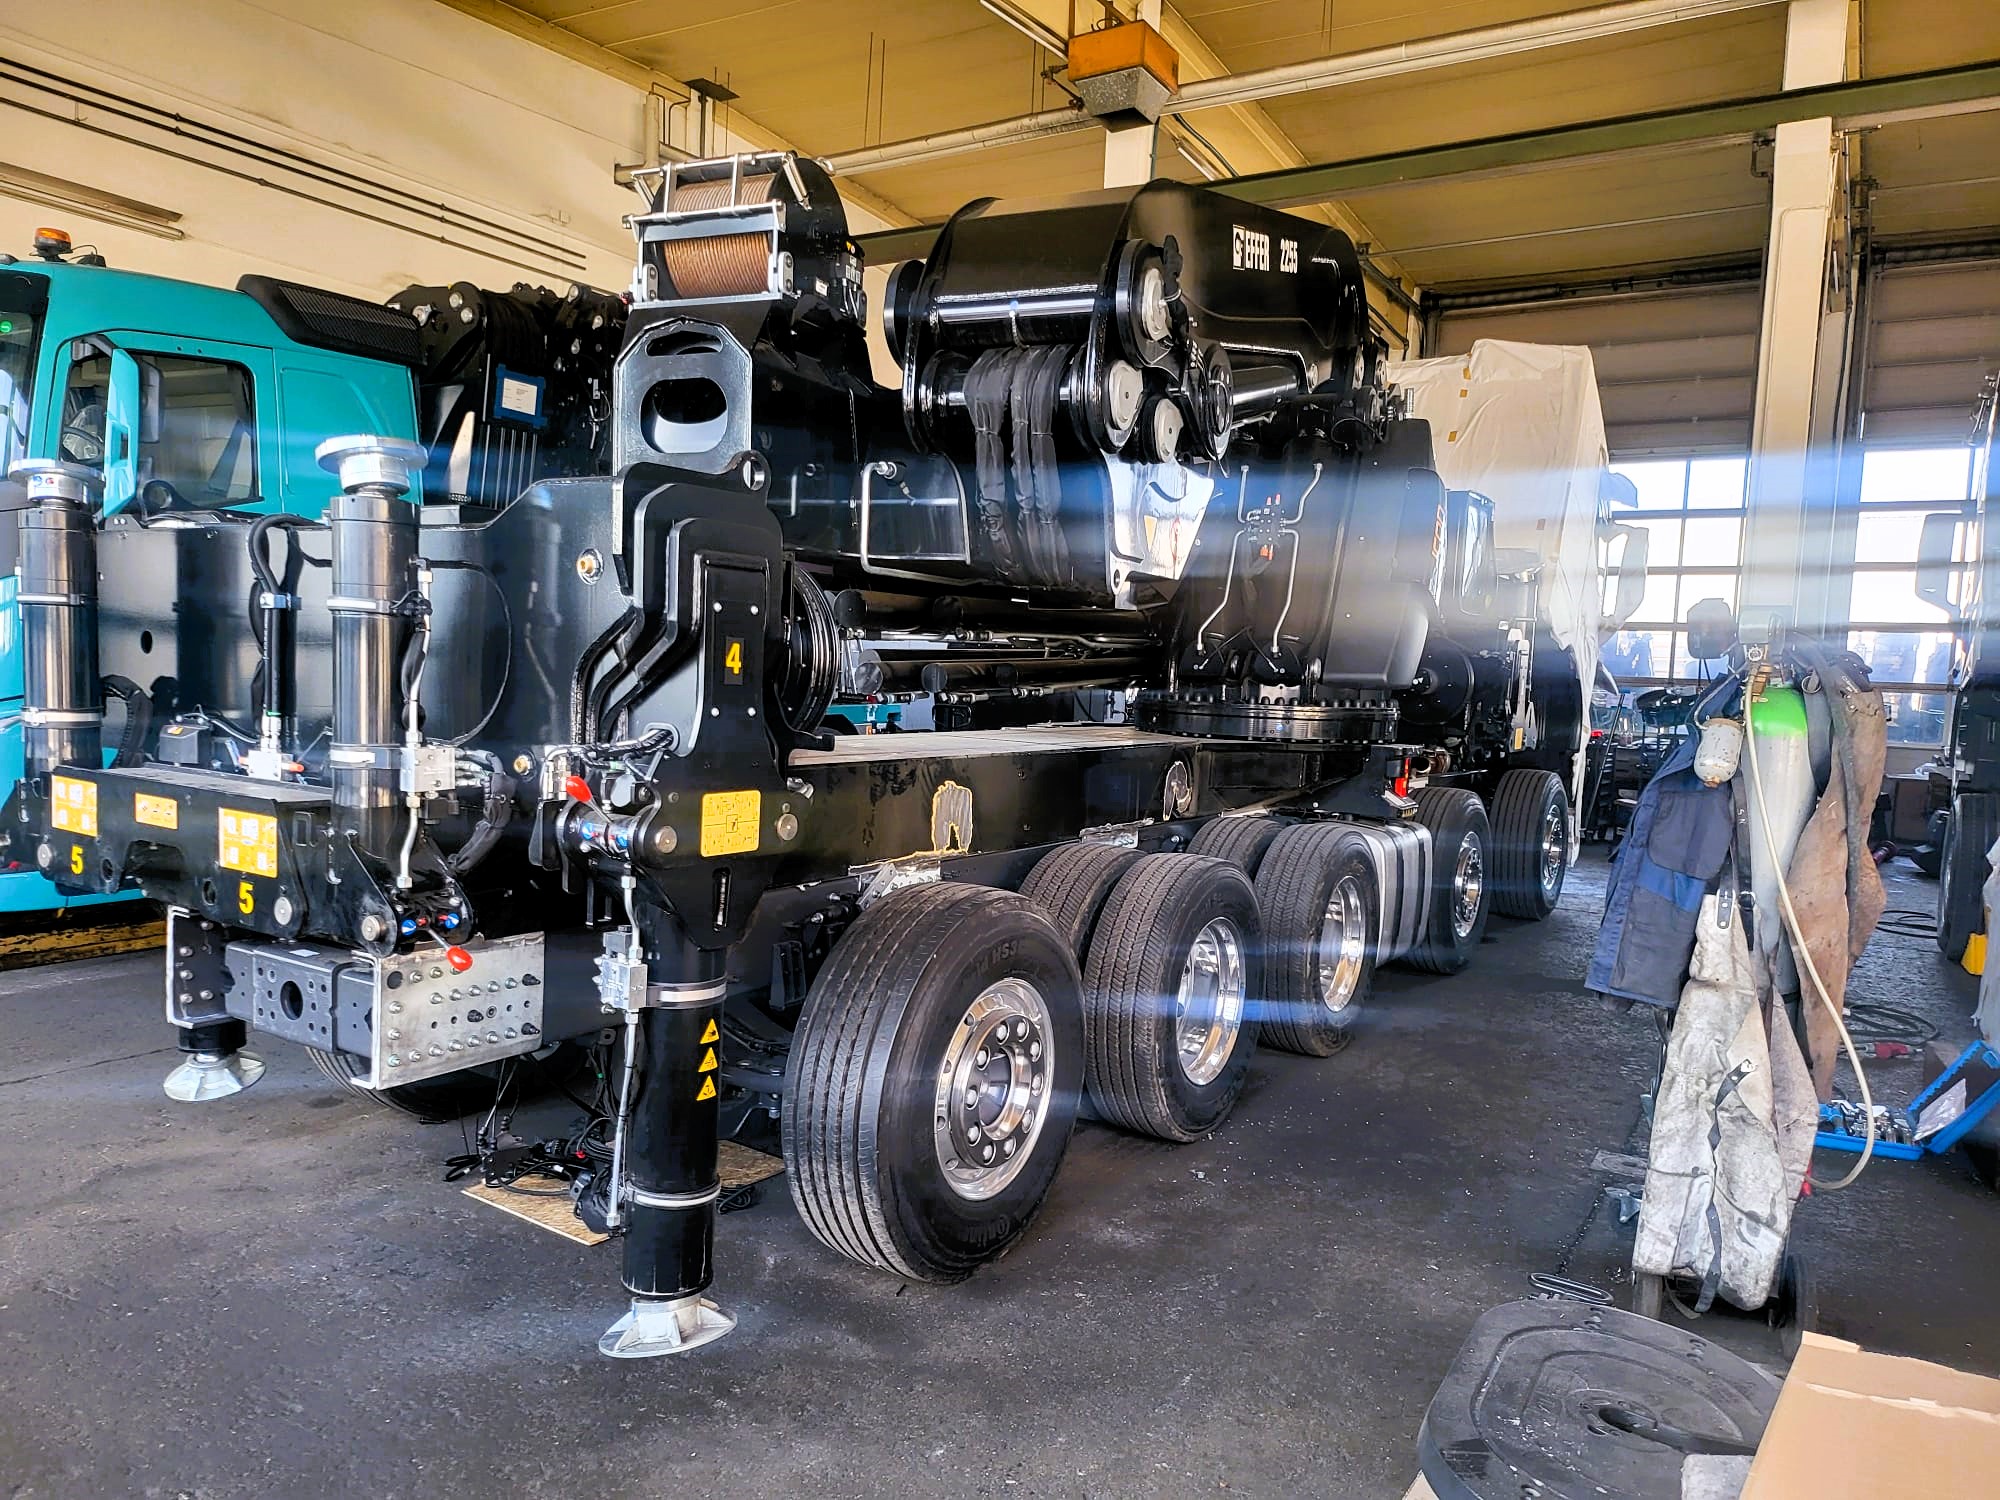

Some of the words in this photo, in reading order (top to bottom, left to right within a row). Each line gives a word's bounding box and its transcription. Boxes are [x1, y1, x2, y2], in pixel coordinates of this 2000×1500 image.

[1245, 229, 1270, 271] EFFER
[1280, 238, 1298, 273] 2255
[725, 642, 742, 675] 4
[71, 844, 84, 875] 5
[239, 881, 255, 915] 5
